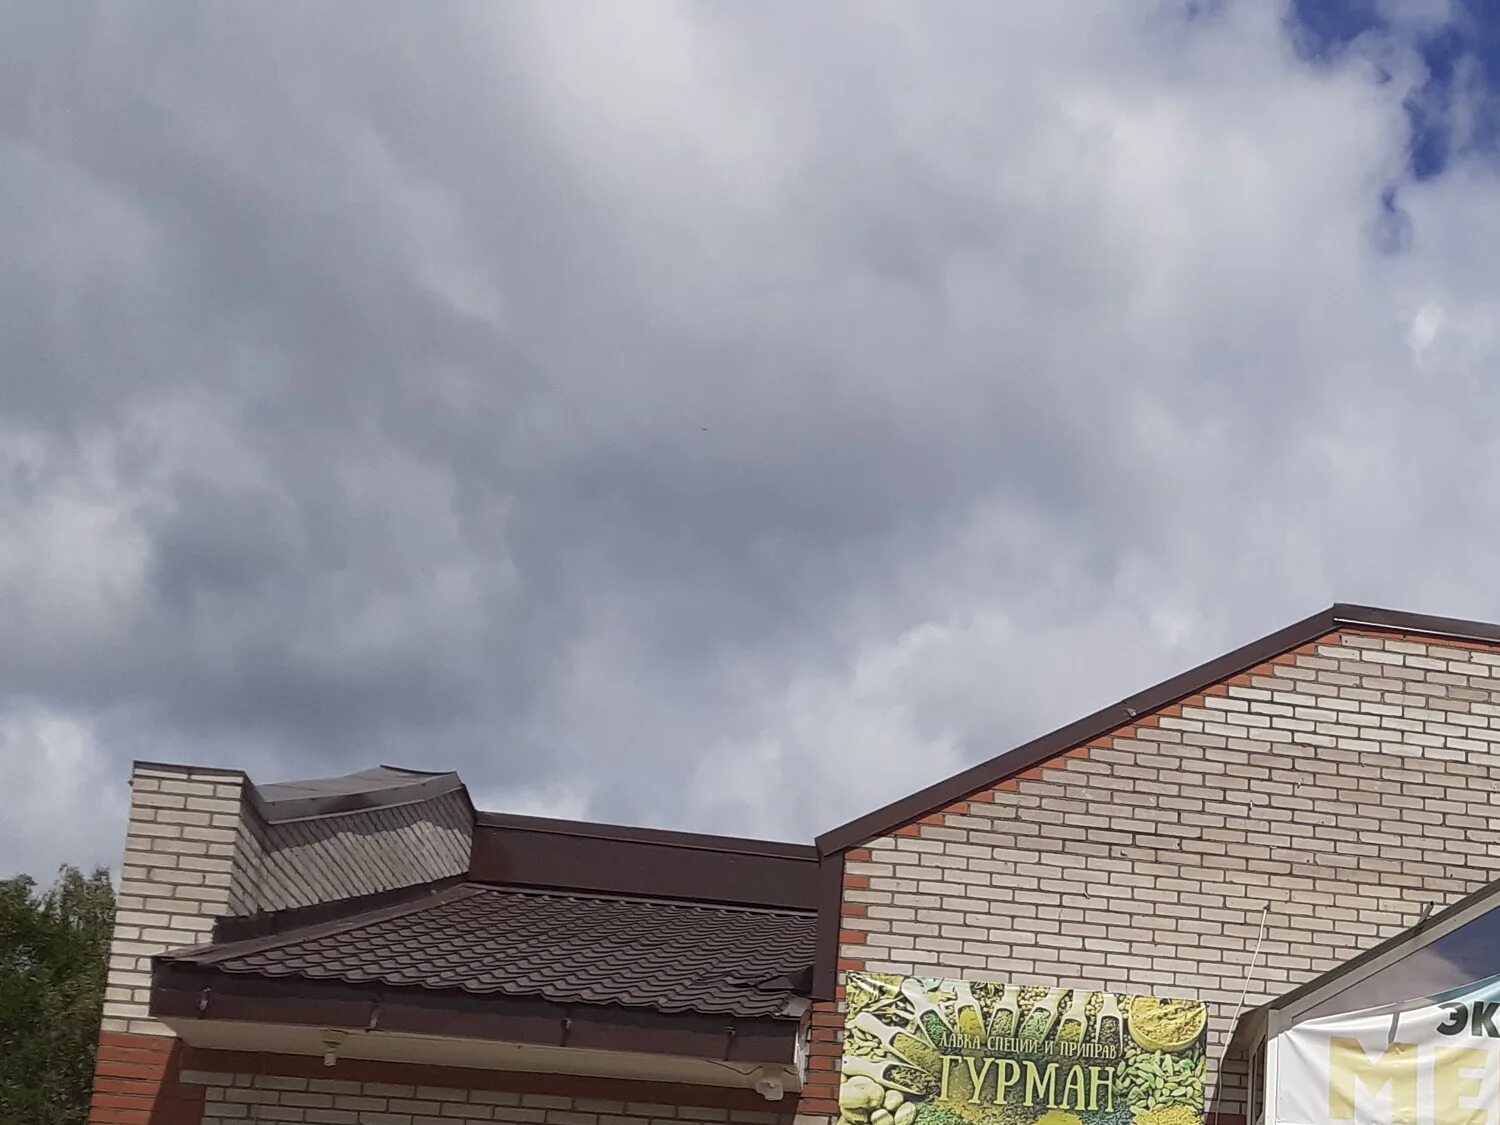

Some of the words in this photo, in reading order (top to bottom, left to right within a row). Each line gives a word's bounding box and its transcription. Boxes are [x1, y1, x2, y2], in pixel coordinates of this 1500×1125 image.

[940, 1032, 980, 1049] ЛАВКА
[1045, 1041, 1055, 1055] И
[1060, 1042, 1117, 1059] ПРИПРАВ
[939, 1055, 1115, 1112] ГУРМАН
